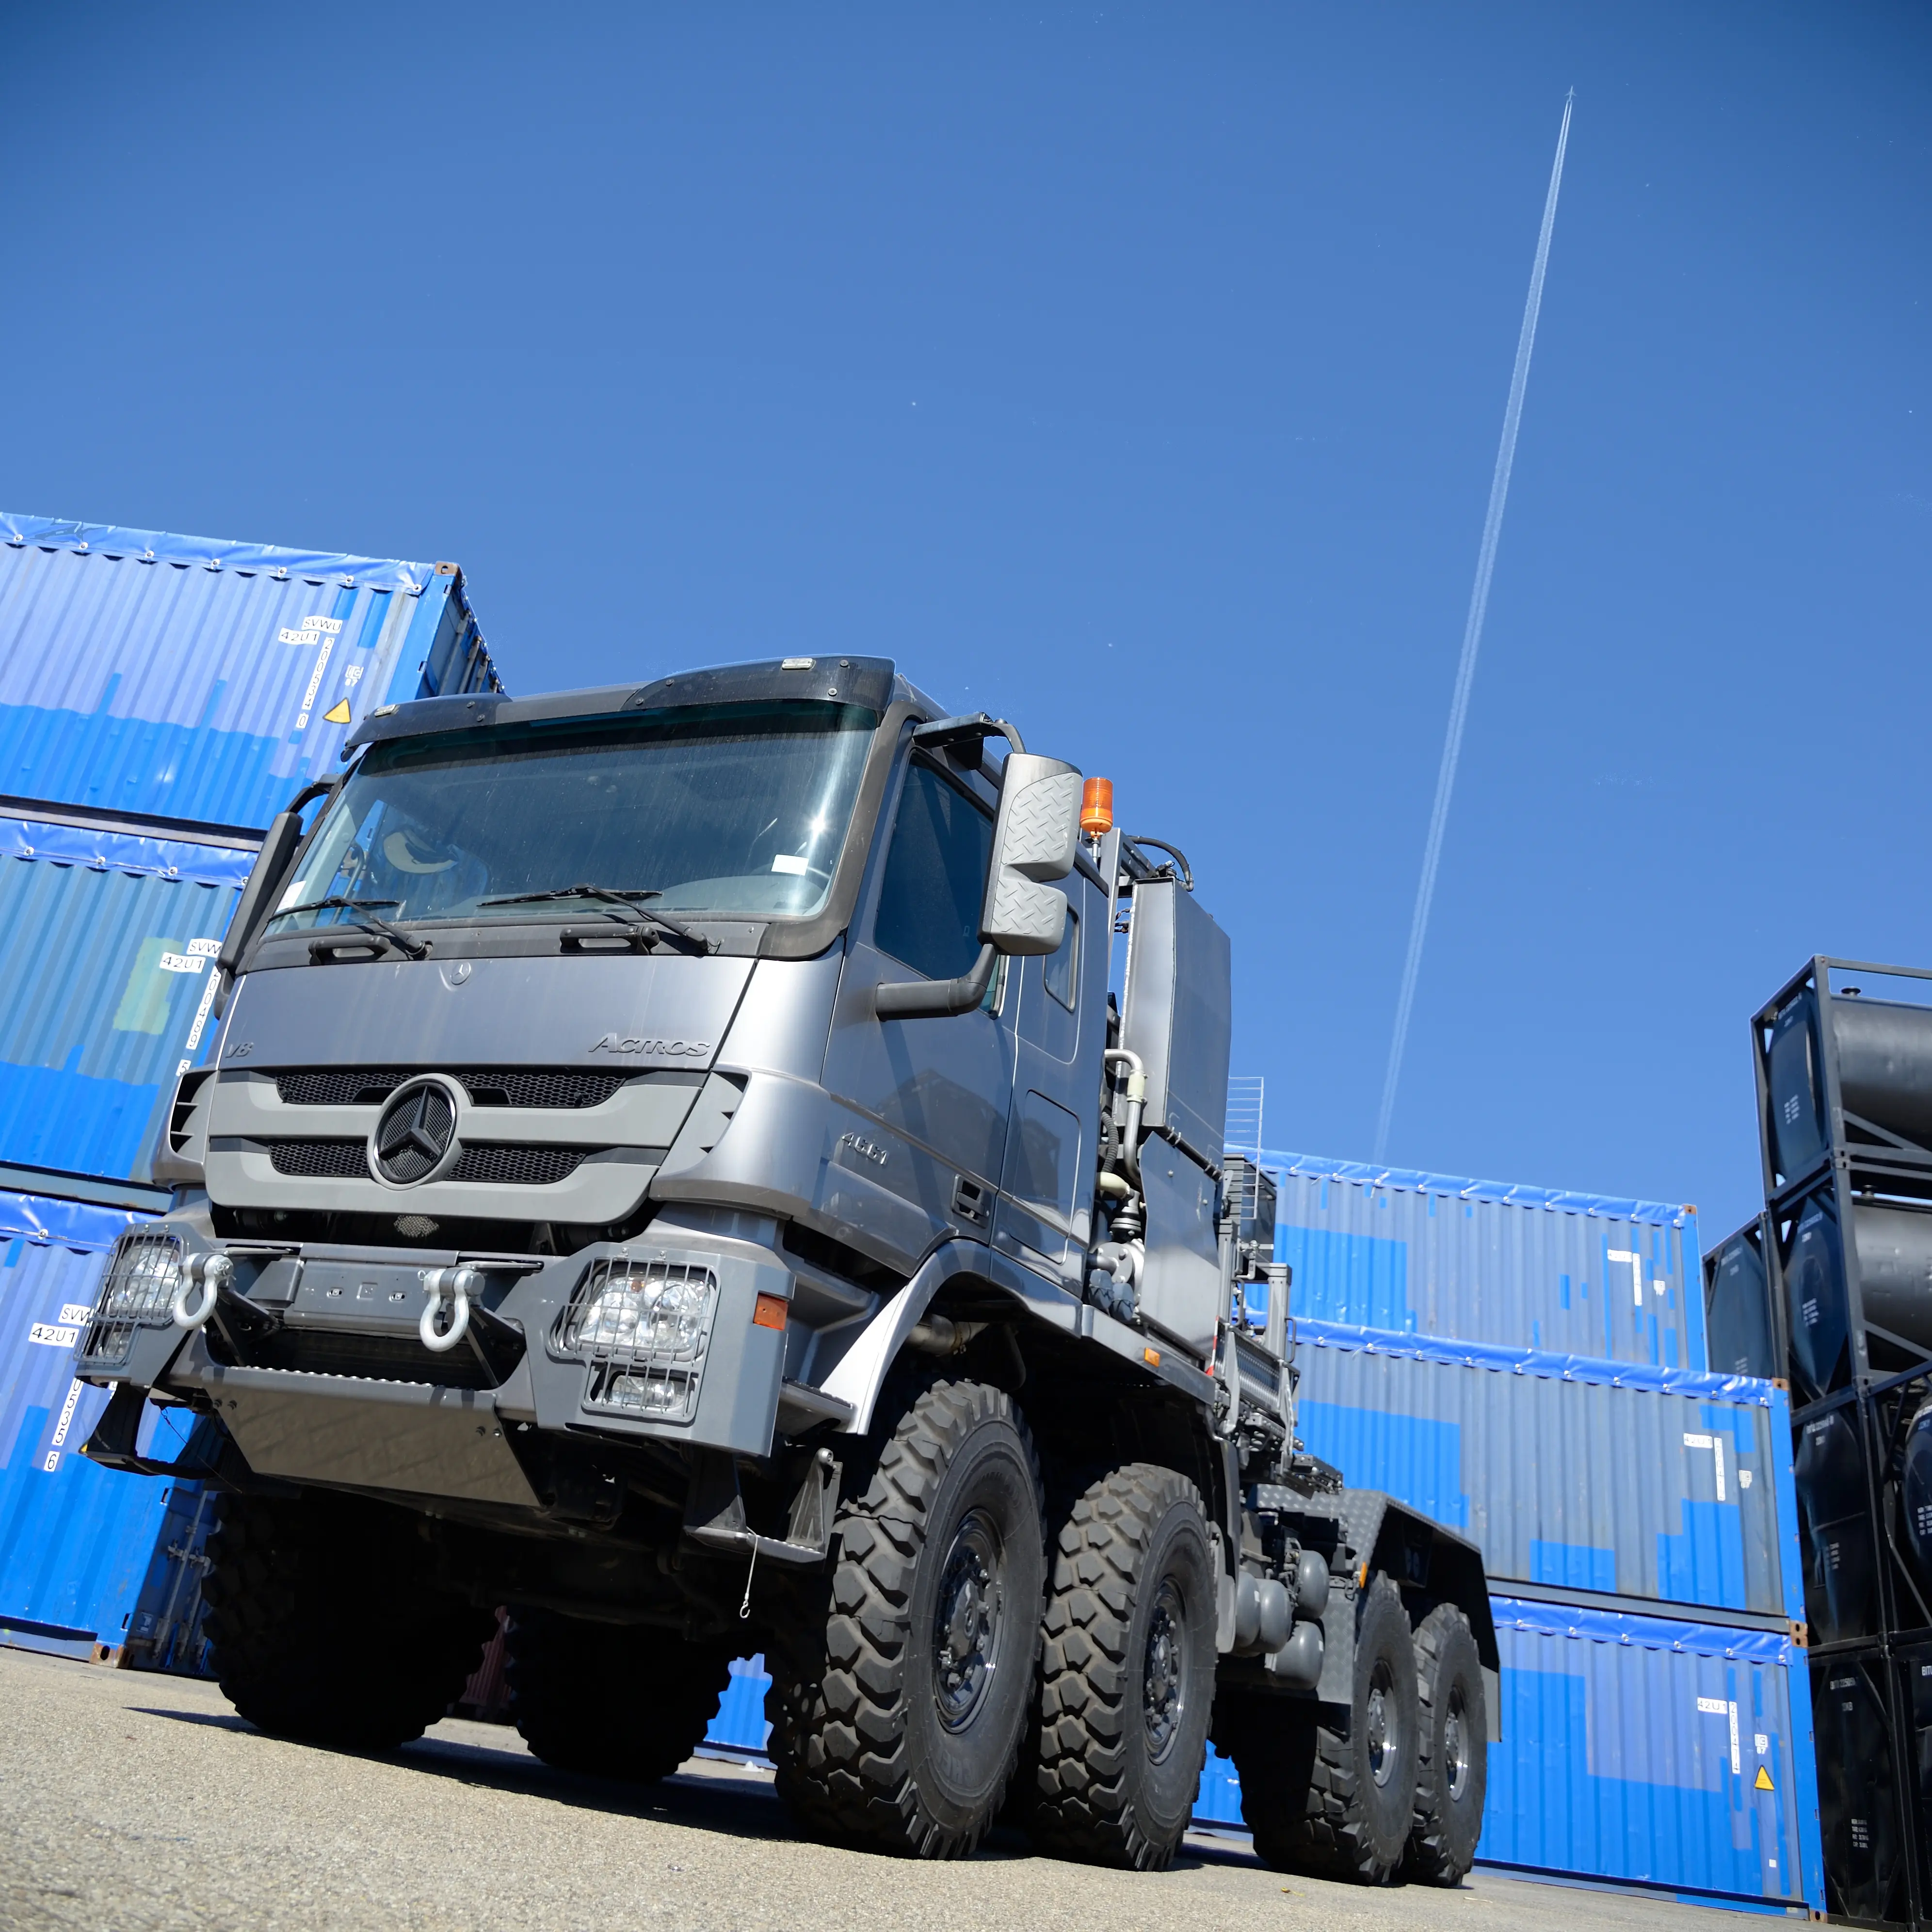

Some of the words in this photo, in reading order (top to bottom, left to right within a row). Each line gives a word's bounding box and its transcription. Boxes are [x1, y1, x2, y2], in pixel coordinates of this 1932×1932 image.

[304, 619, 341, 630] SVWU
[281, 632, 317, 641] 42U1
[305, 639, 333, 708] 200534
[190, 942, 222, 954] SVW
[163, 957, 202, 969] 42U1
[62, 1308, 89, 1321] SV
[32, 1327, 76, 1343] 42U1
[56, 1379, 81, 1444] 0535
[1684, 1435, 1712, 1445] 42U1
[48, 1454, 57, 1469] 6
[1698, 1701, 1726, 1710] 42U1
[1730, 1703, 1739, 1771] 200474
